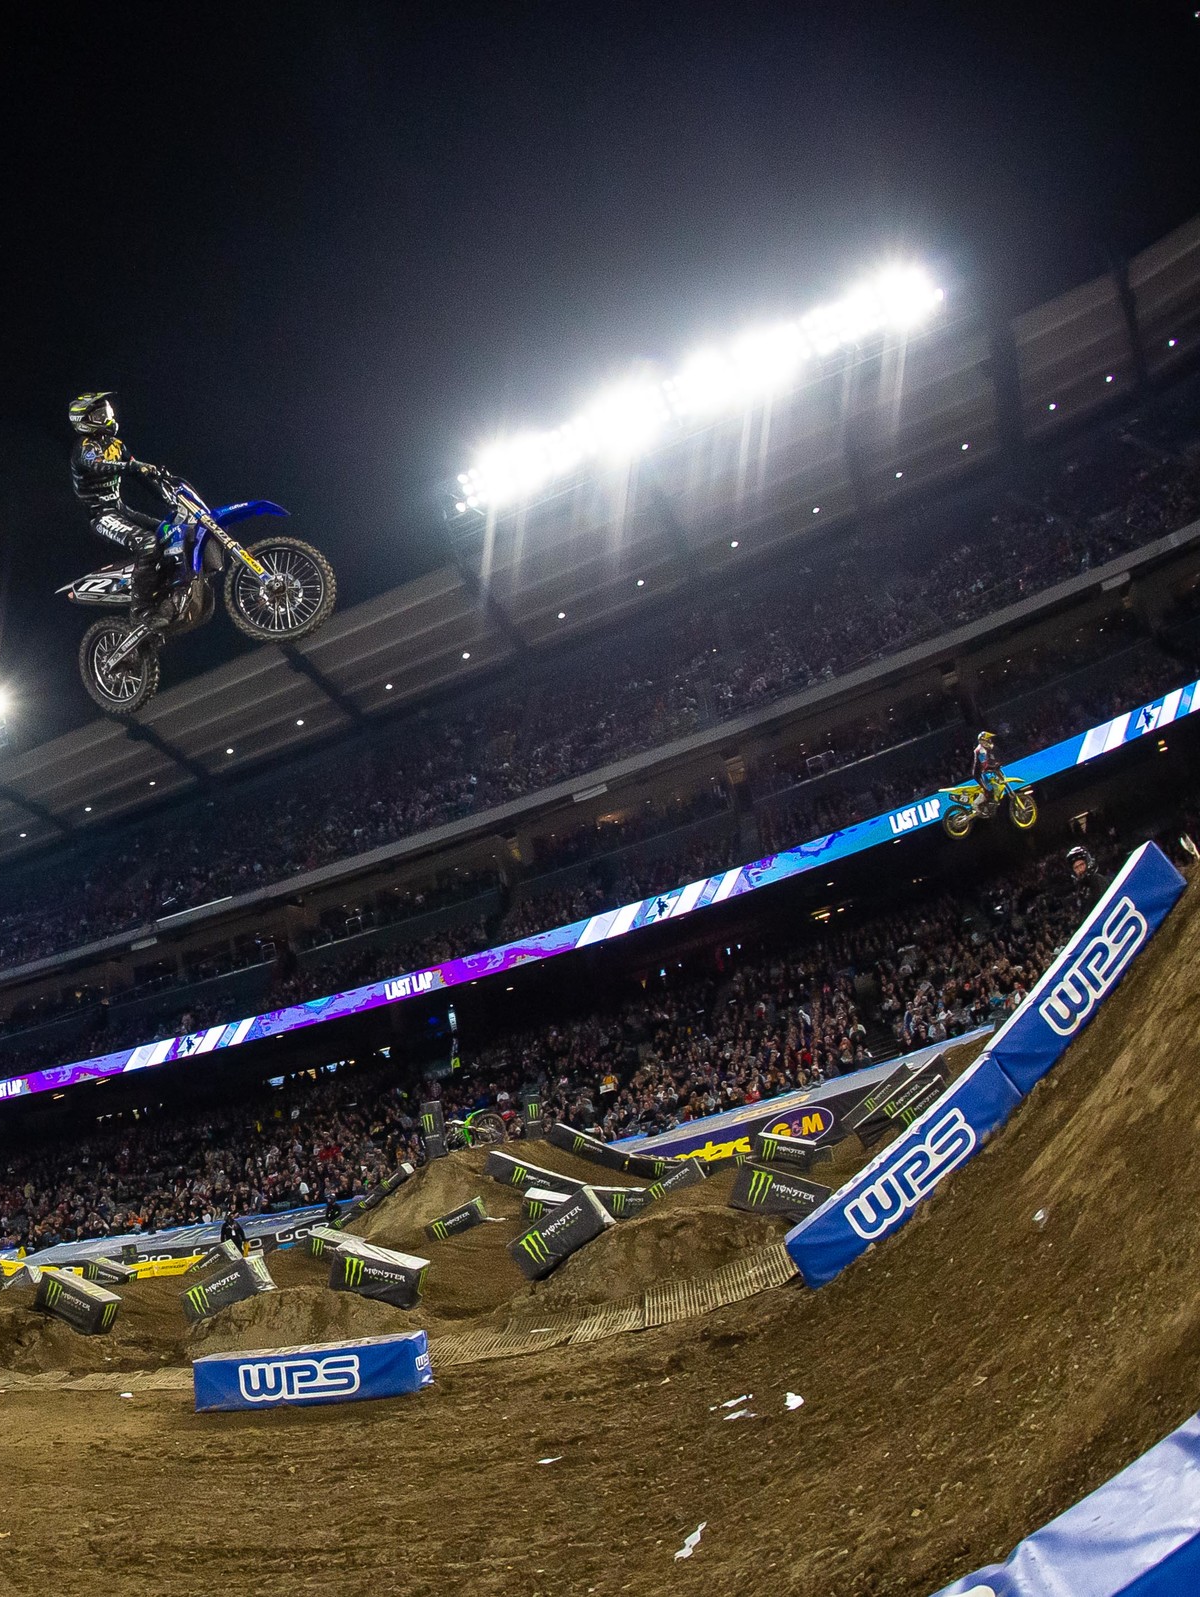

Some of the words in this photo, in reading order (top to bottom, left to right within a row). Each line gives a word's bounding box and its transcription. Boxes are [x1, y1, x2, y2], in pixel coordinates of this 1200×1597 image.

[889, 806, 919, 834] LAST
[917, 798, 941, 823] LAP
[1038, 896, 1148, 1036] WPS
[384, 977, 411, 1000] LAST
[411, 971, 433, 993] LAP
[7, 1079, 22, 1096] LAP
[776, 1145, 806, 1157] MONSTER
[844, 1107, 976, 1240] WPS
[771, 1182, 816, 1203] MONSTER
[444, 1211, 471, 1227] MONSTER
[541, 1205, 583, 1238] MONSTER
[205, 1271, 241, 1294] MONSTER
[363, 1267, 406, 1283] MONSTER
[61, 1291, 91, 1311] MONSTER
[238, 1354, 361, 1402] WPS
